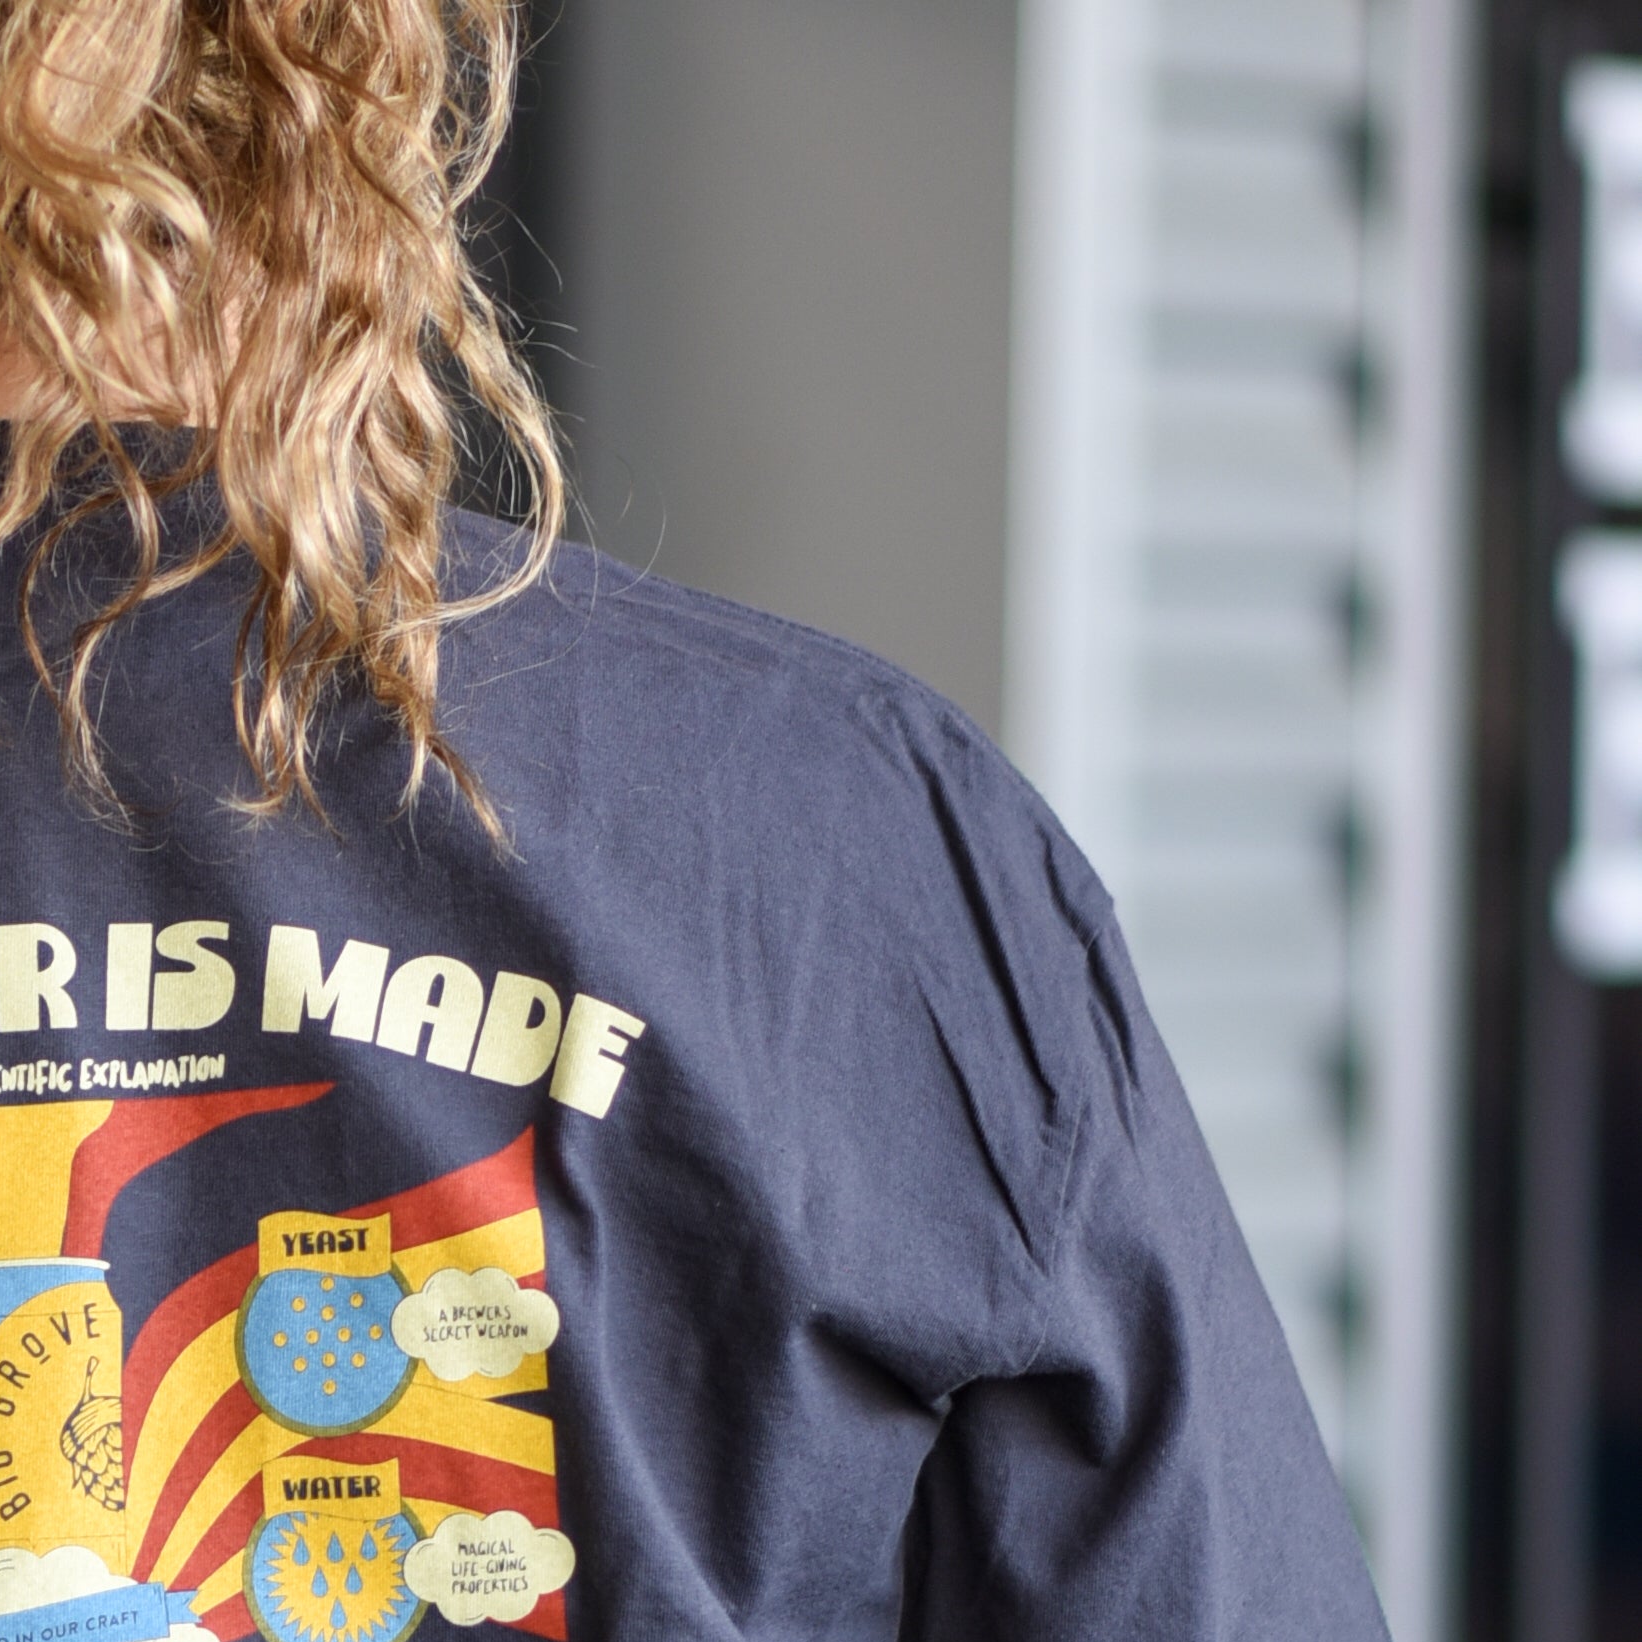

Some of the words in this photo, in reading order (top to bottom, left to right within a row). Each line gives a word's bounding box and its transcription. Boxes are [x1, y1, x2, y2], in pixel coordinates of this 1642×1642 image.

[105, 920, 235, 1031] IS
[262, 925, 646, 1119] MADE
[79, 1053, 226, 1090] EXPLANATION
[282, 1228, 369, 1257] YEAST
[439, 1309, 448, 1322] A
[453, 1305, 511, 1322] BREWERS
[423, 1324, 472, 1342] SECRET
[476, 1323, 528, 1339] WEAPON
[282, 1475, 381, 1501] WATER
[458, 1538, 515, 1556] MAGICAL
[452, 1575, 528, 1595] PROPERTIES
[41, 1621, 79, 1642] OUR
[85, 1610, 139, 1631] CRAFT
